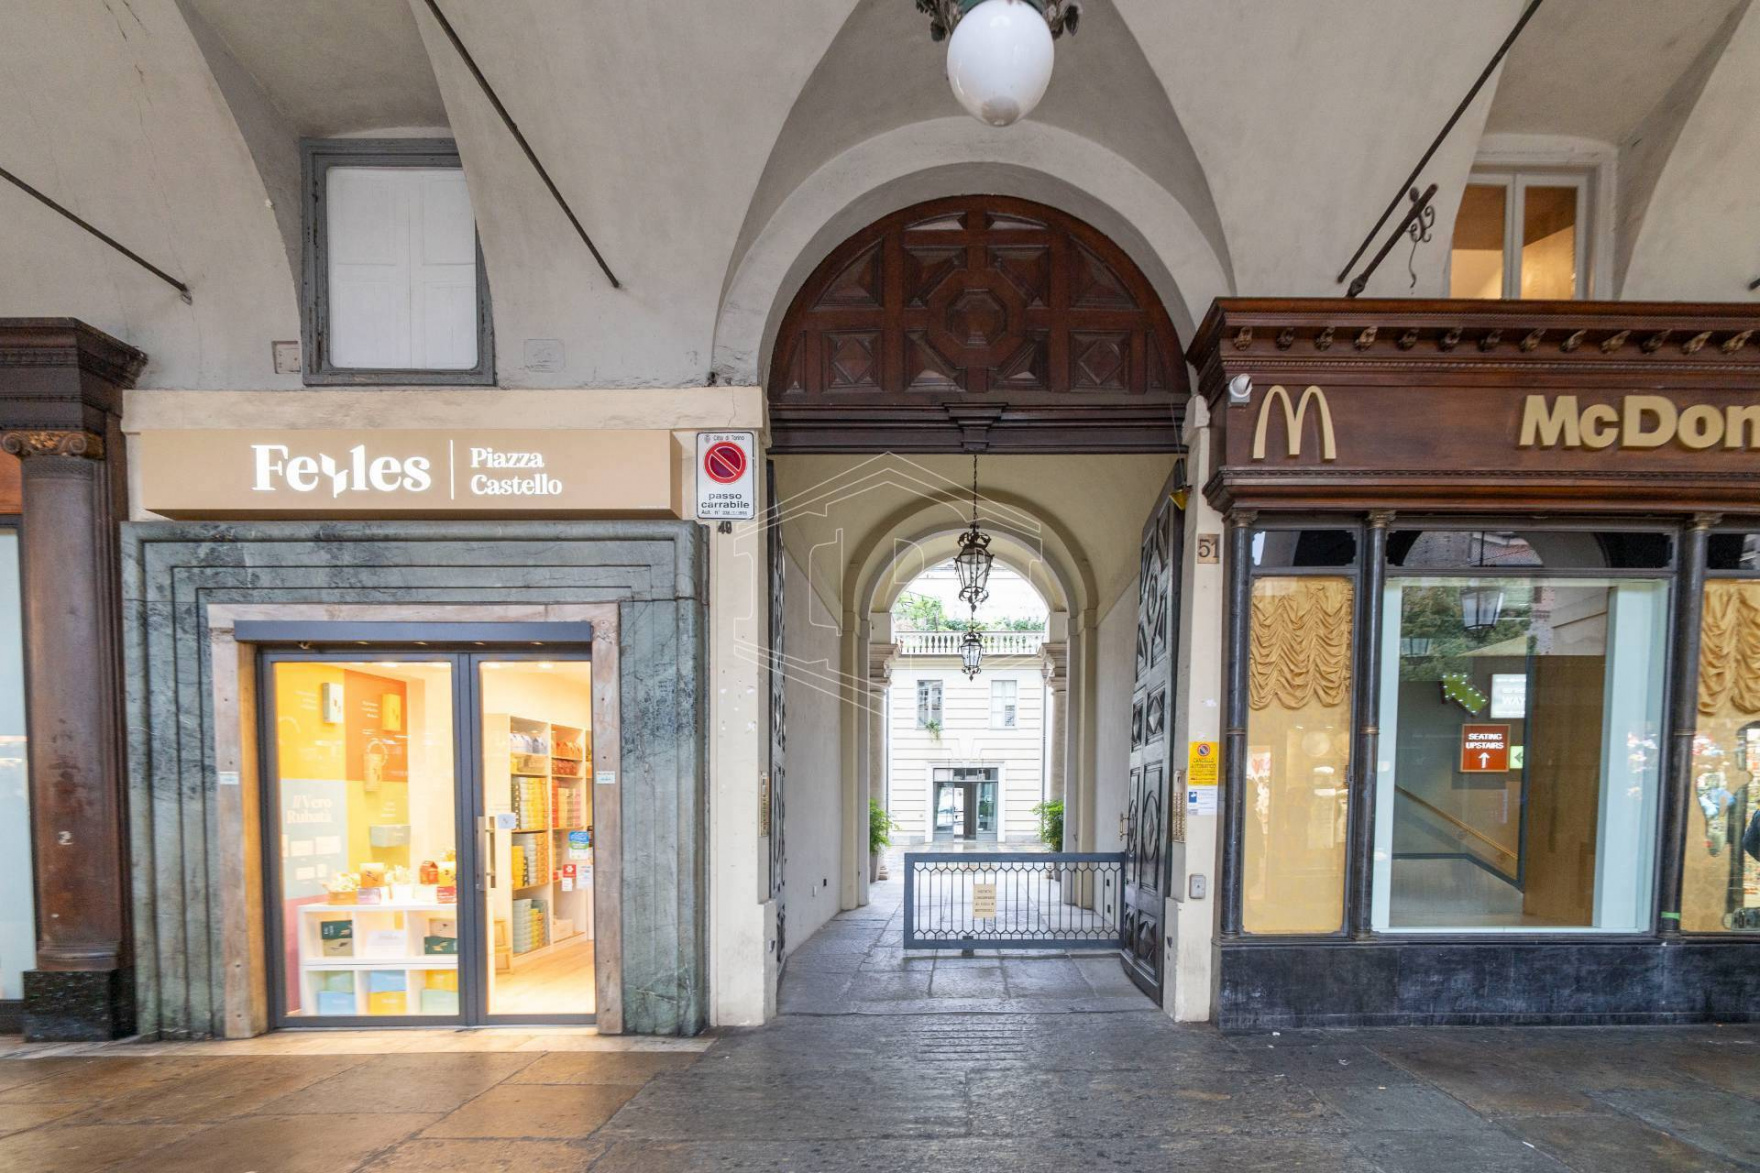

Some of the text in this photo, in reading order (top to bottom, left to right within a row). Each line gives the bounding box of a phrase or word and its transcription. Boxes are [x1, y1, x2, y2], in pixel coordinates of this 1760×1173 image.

[1519, 394, 1760, 449] McDon
[470, 447, 545, 468] Piazza
[250, 444, 431, 498] Feyles
[470, 474, 563, 495] Castello
[701, 501, 750, 509] carrabile
[1198, 538, 1219, 558] 51
[1465, 742, 1504, 750] UPSTAIRS
